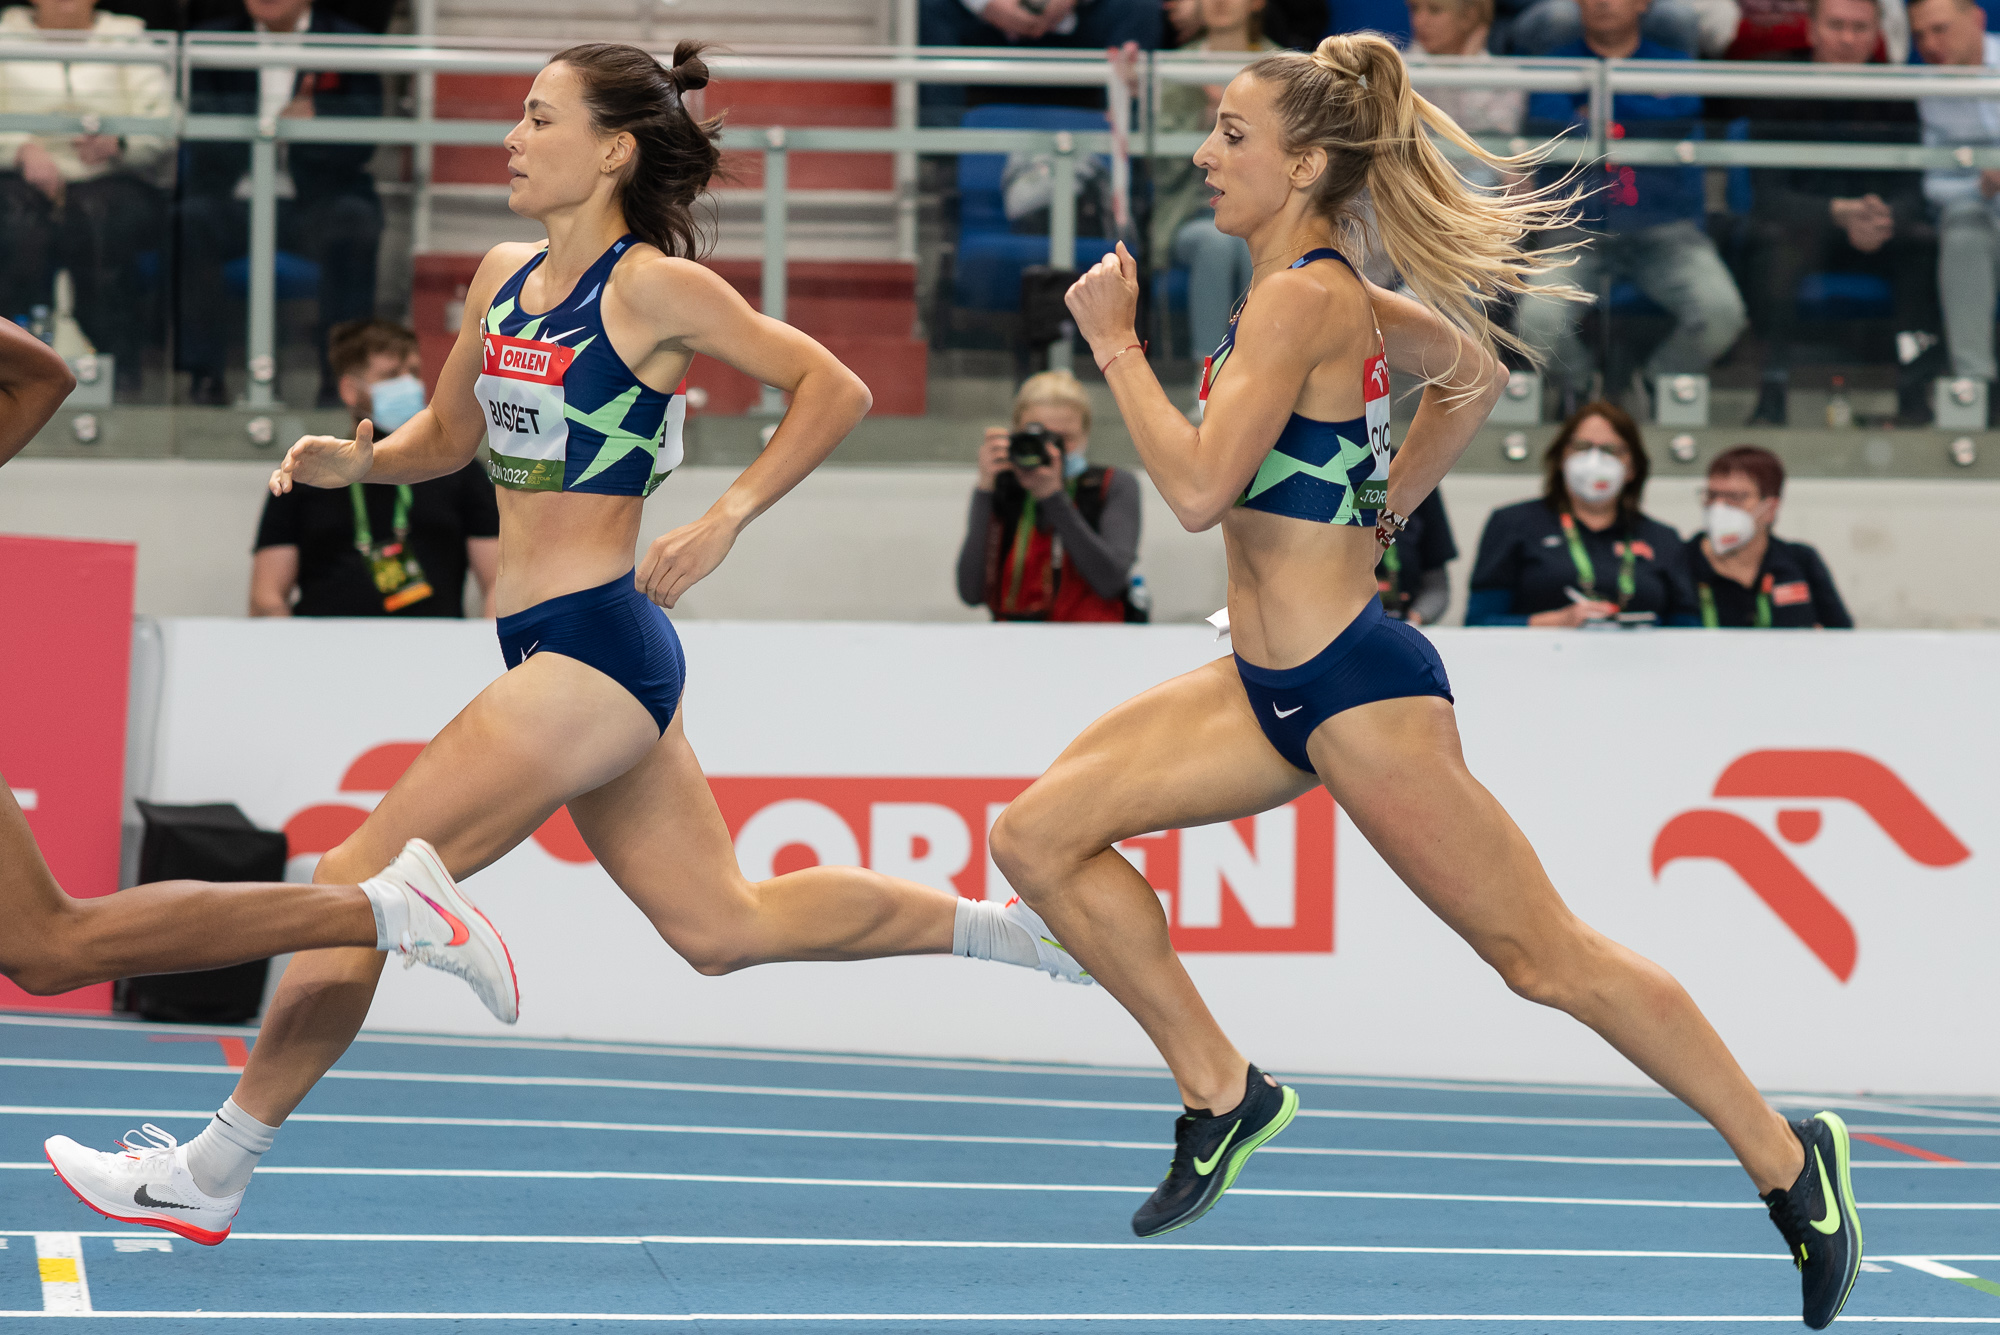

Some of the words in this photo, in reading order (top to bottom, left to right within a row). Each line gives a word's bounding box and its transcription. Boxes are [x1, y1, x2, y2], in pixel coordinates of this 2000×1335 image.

[503, 349, 547, 373] ORLEN
[488, 399, 541, 435] BISSET
[503, 467, 529, 485] 2022
